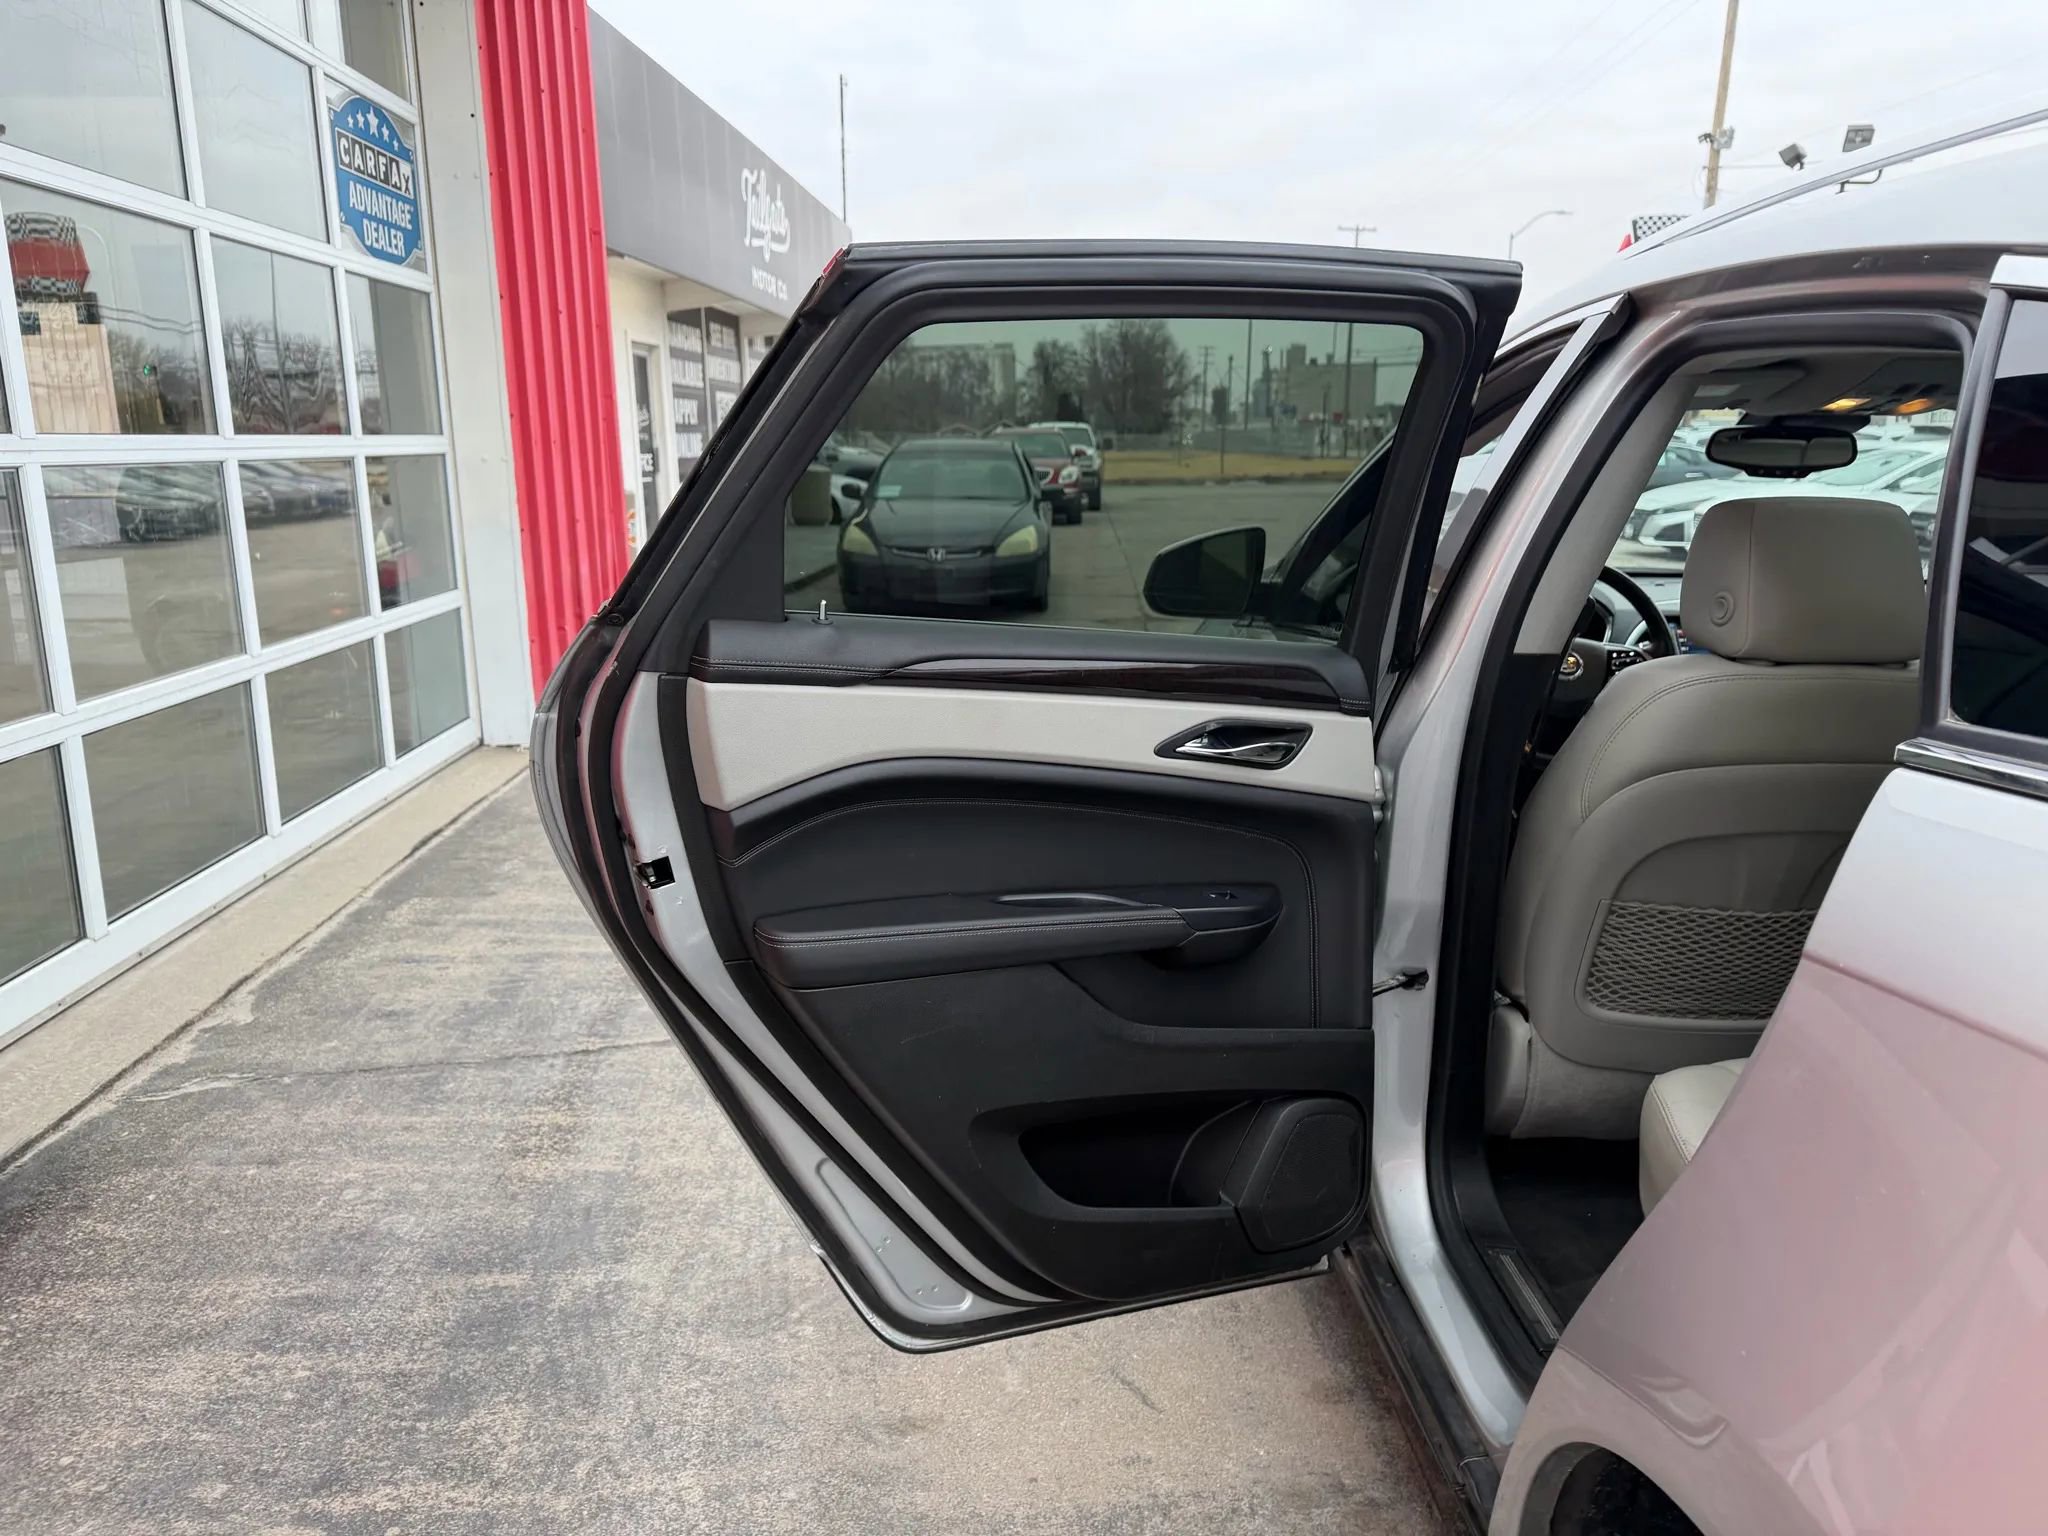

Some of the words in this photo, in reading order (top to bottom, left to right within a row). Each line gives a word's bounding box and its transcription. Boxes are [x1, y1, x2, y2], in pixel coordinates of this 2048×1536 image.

[339, 137, 411, 196] CARFAX
[349, 180, 413, 231] ADVANTAGE
[362, 218, 405, 258] DEALER
